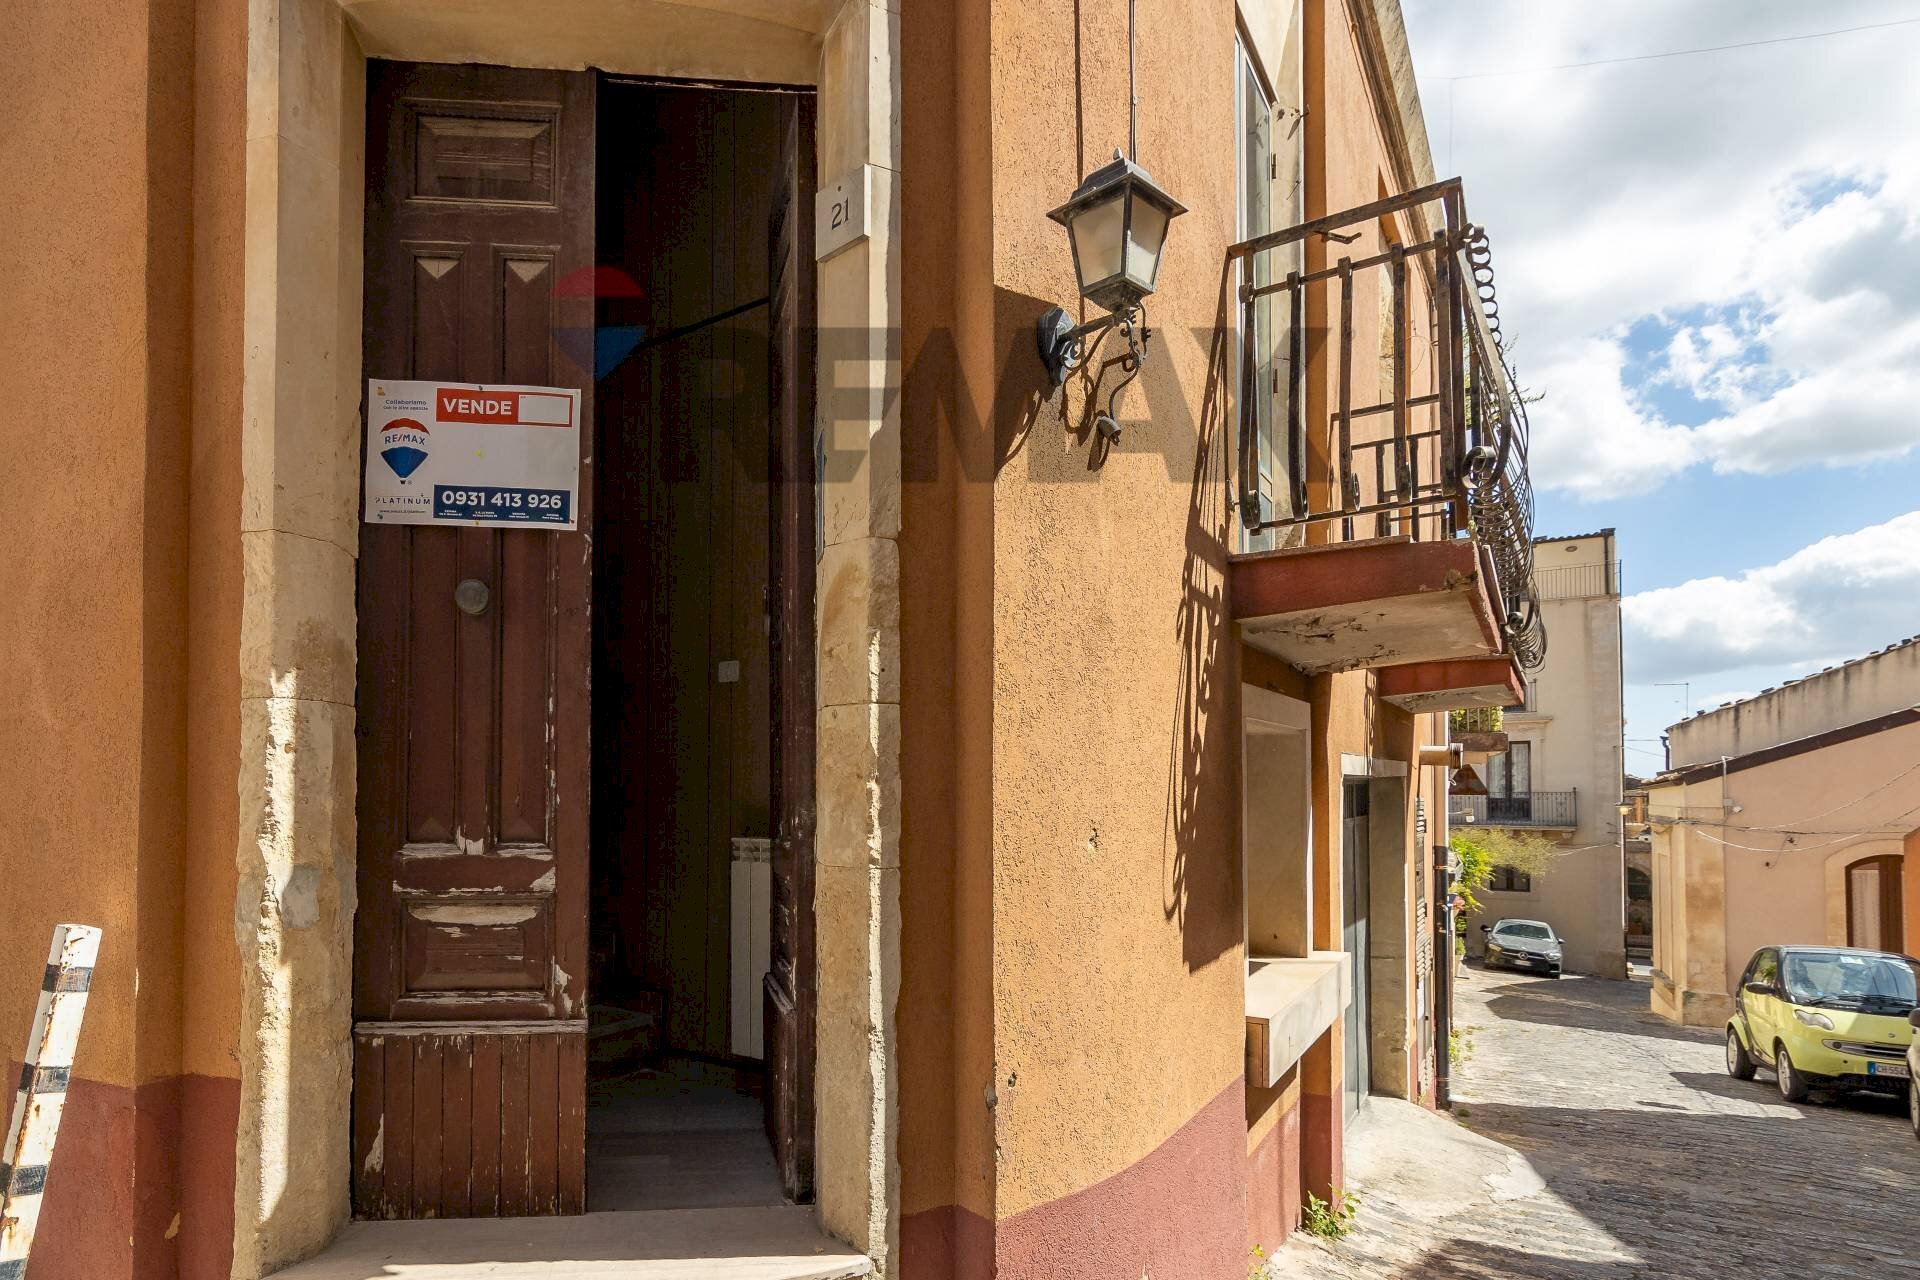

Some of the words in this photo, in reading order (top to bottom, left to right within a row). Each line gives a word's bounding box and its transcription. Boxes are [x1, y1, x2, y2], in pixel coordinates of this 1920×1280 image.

[831, 196, 849, 231] 21
[443, 397, 512, 416] VENDE
[384, 433, 426, 446] RE/MAX
[375, 496, 431, 505] PLATINUM
[442, 490, 486, 506] 0931
[490, 492, 522, 507] 413
[527, 494, 562, 509] 926
